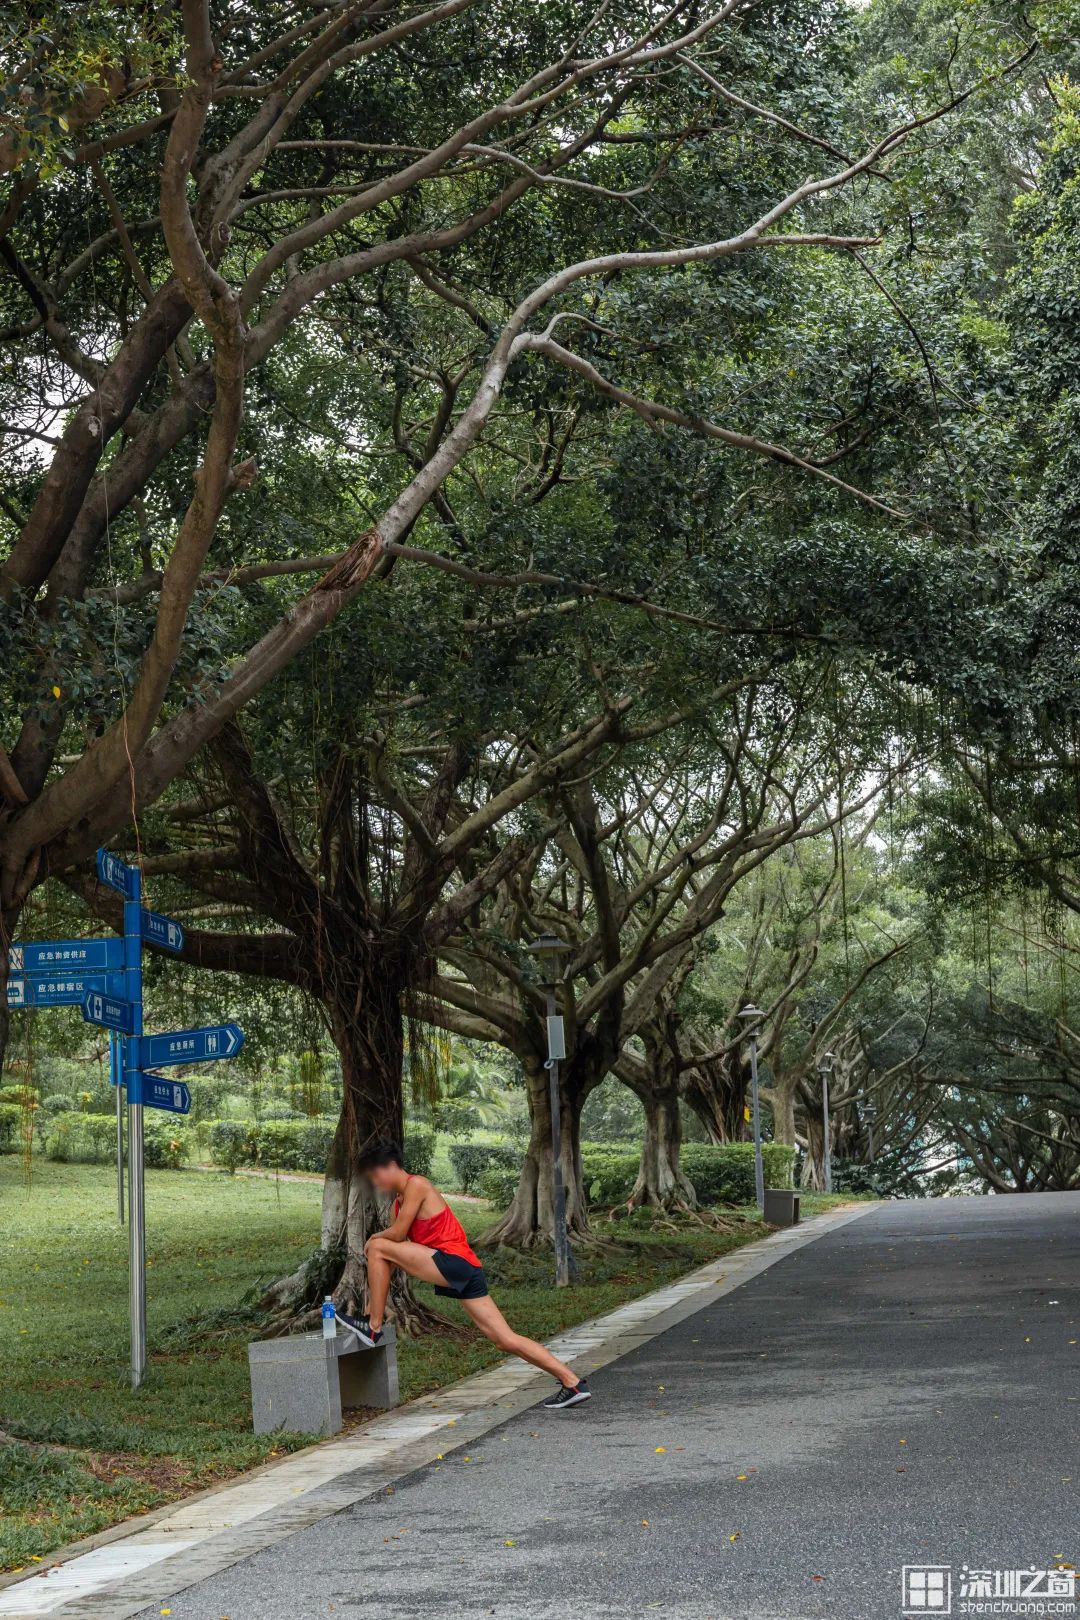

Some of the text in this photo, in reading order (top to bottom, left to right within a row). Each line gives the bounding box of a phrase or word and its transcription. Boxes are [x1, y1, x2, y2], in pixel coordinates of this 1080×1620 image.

[38, 950, 87, 960] 应急物资供应
[169, 1039, 195, 1052] 应急厕所
